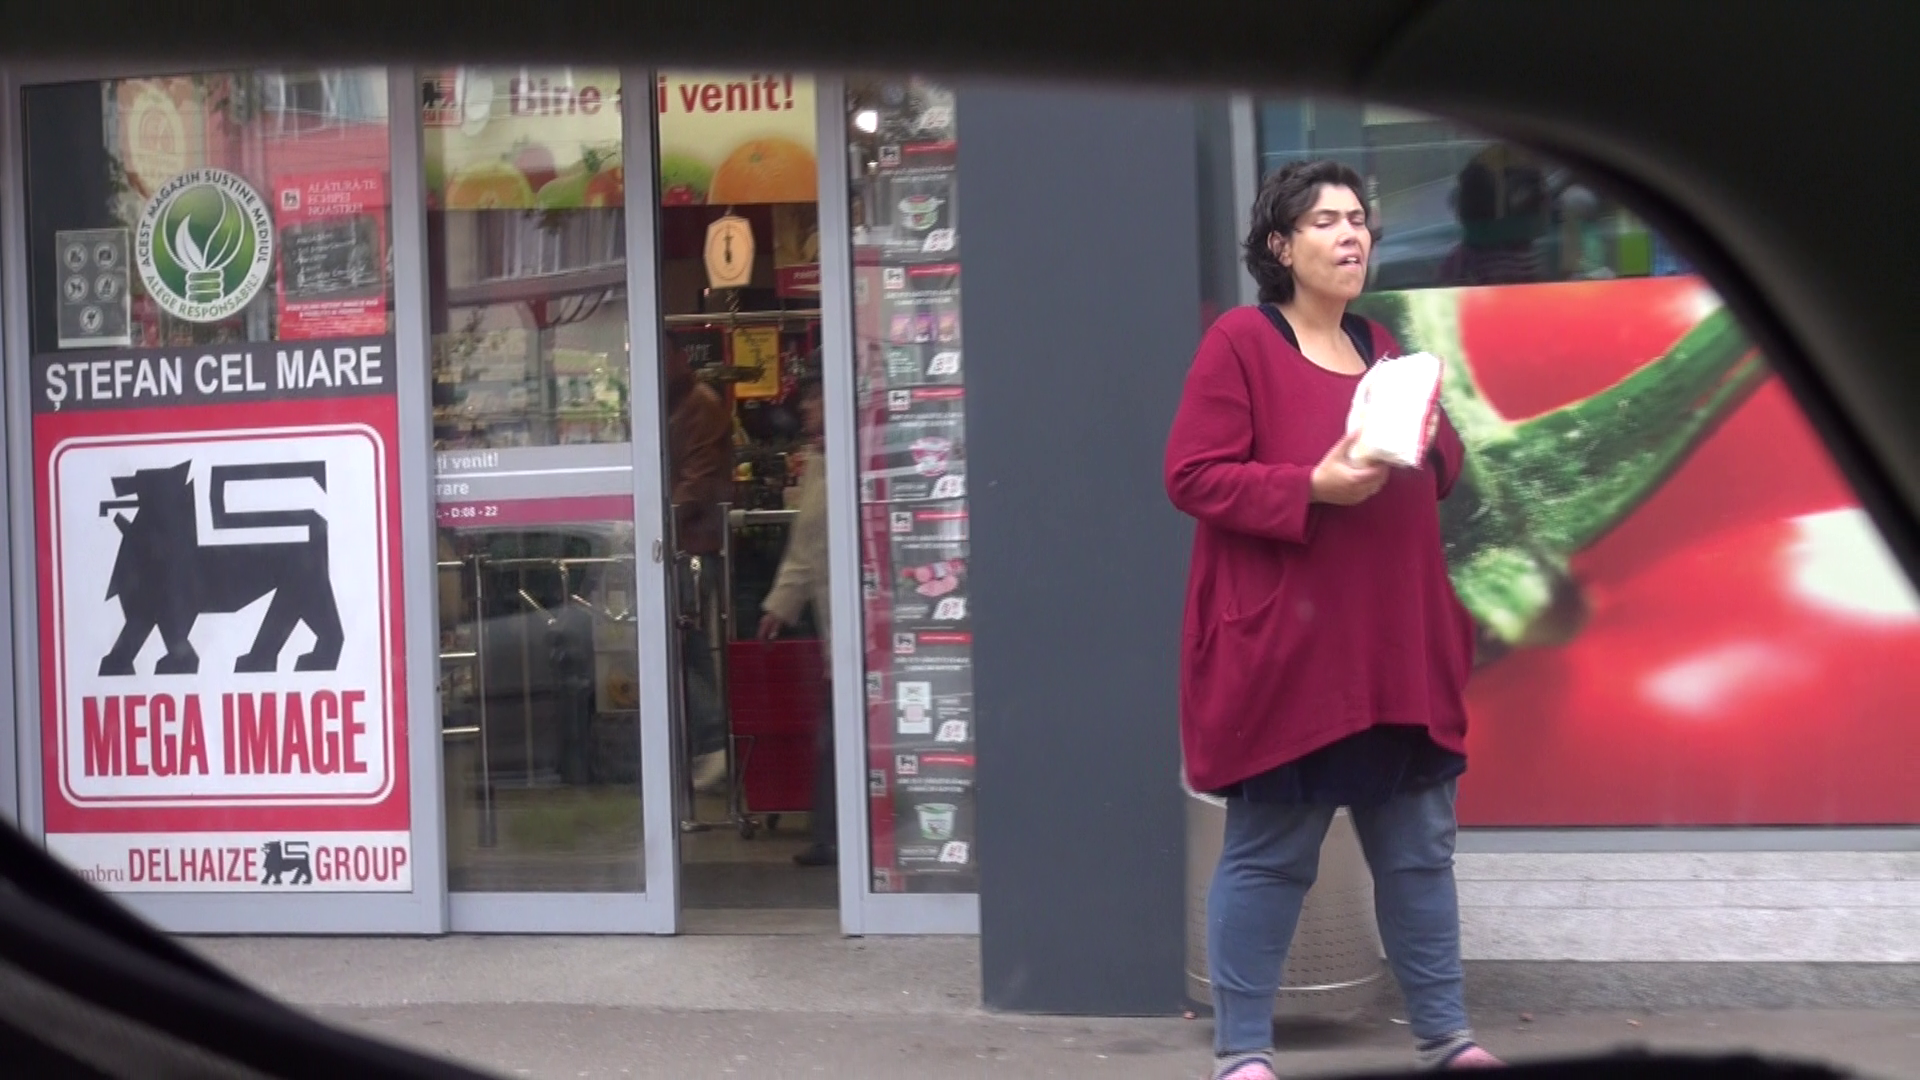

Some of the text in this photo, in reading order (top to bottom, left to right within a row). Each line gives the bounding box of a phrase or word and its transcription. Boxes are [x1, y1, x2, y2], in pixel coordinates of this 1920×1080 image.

[679, 71, 794, 114] venit!
[138, 220, 151, 267] ACEST
[148, 172, 200, 218] MAGAZIN
[204, 170, 256, 205] SUSTINE
[251, 208, 270, 264] MEDIUL
[145, 275, 178, 309] ALEGE
[46, 345, 383, 411] ȘTEFAN CEL MARE
[452, 452, 499, 469] venit!
[485, 505, 498, 517] 22
[82, 689, 368, 777] MEGA IMAGE
[128, 847, 258, 883] DELHAIZE
[315, 845, 407, 882] GROUP
